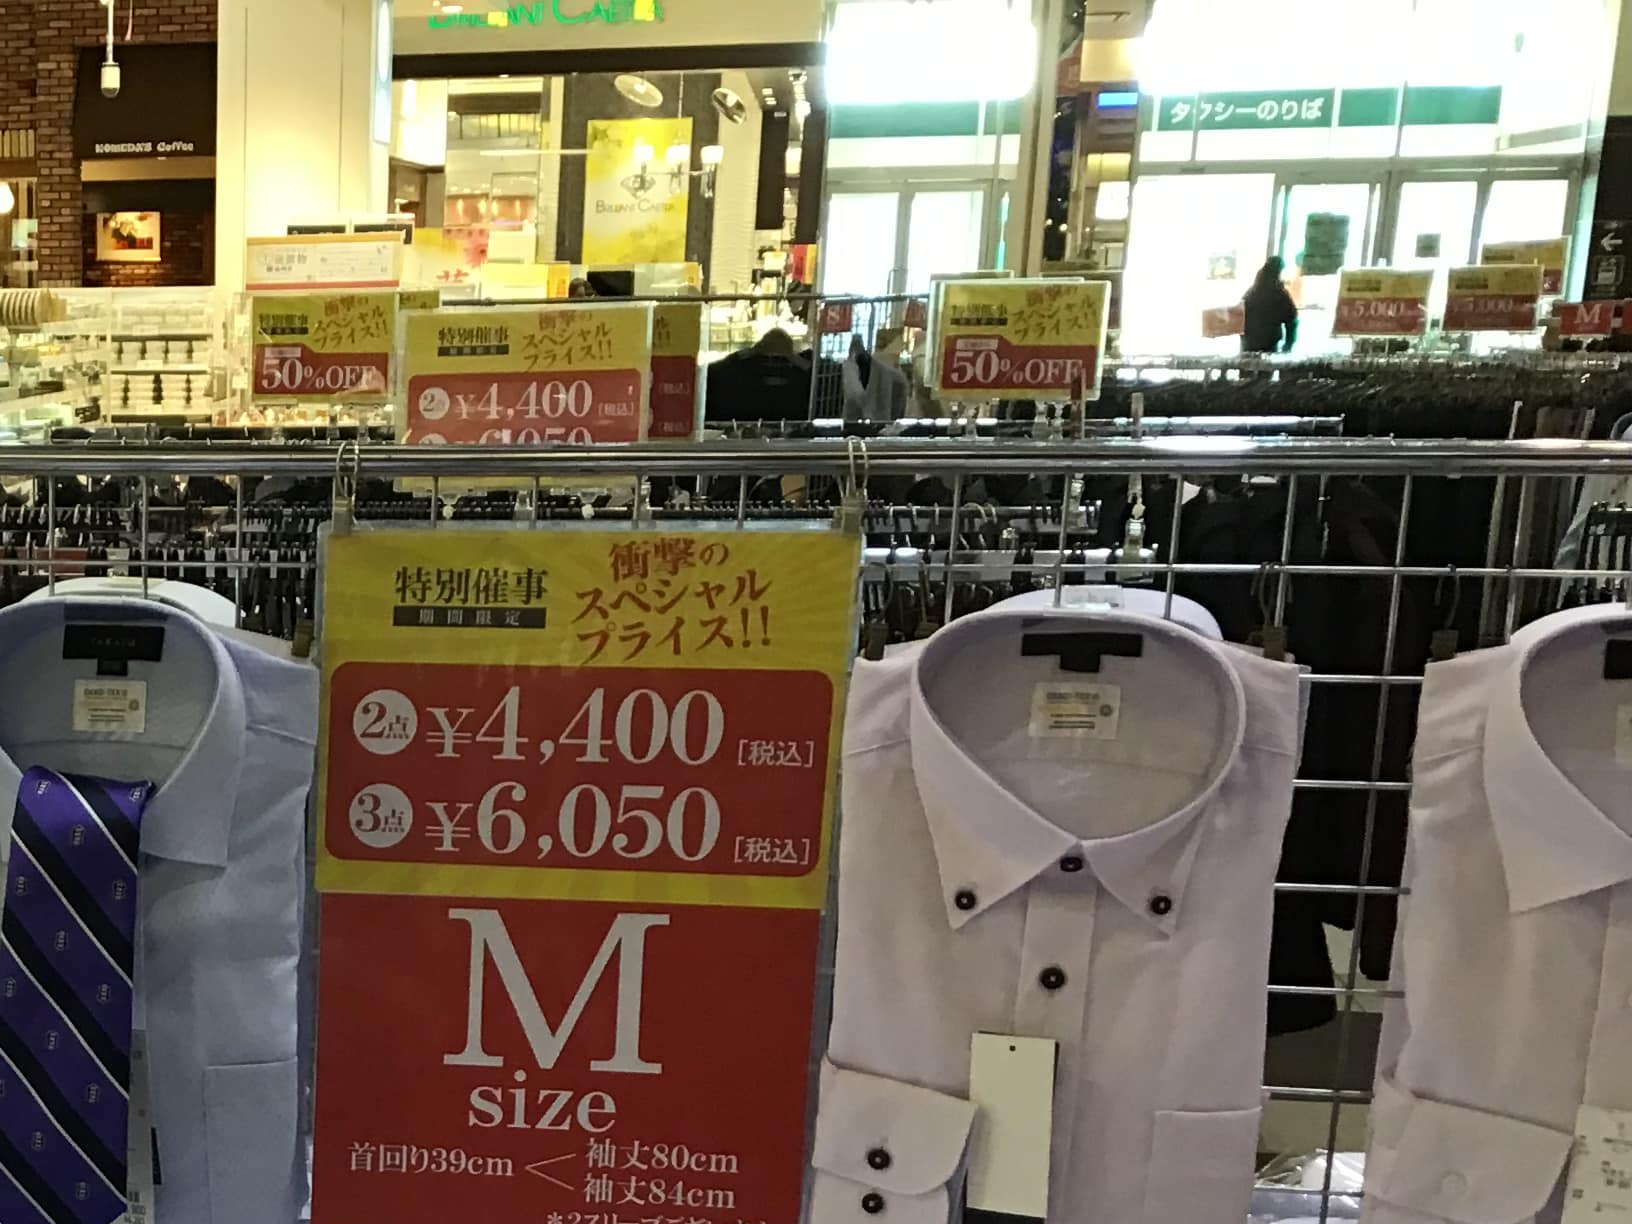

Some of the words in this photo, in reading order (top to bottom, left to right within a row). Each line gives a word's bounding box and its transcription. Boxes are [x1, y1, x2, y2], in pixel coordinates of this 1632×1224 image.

[157, 141, 194, 152] Coffee
[1574, 304, 1602, 324] M
[951, 350, 1084, 385] 50%OFF
[455, 380, 594, 421] ¥4,400
[608, 537, 730, 581] 衝撃の
[394, 567, 550, 606] 特別催事
[572, 569, 774, 625] スペシャル
[418, 608, 521, 627] 期間限定
[574, 605, 773, 665] プライス!!
[358, 700, 411, 740] 2点
[426, 685, 725, 766] ¥4,400
[737, 738, 816, 768] [税込]
[354, 792, 407, 834] 3点
[424, 780, 722, 862] ¥6,050
[733, 835, 810, 865] [税込]
[442, 907, 671, 1075] M
[468, 1069, 618, 1134] size
[347, 1141, 515, 1178] 首回り39cm
[584, 1137, 740, 1175] 袖丈80cm
[583, 1172, 738, 1210] 袖丈84cm
